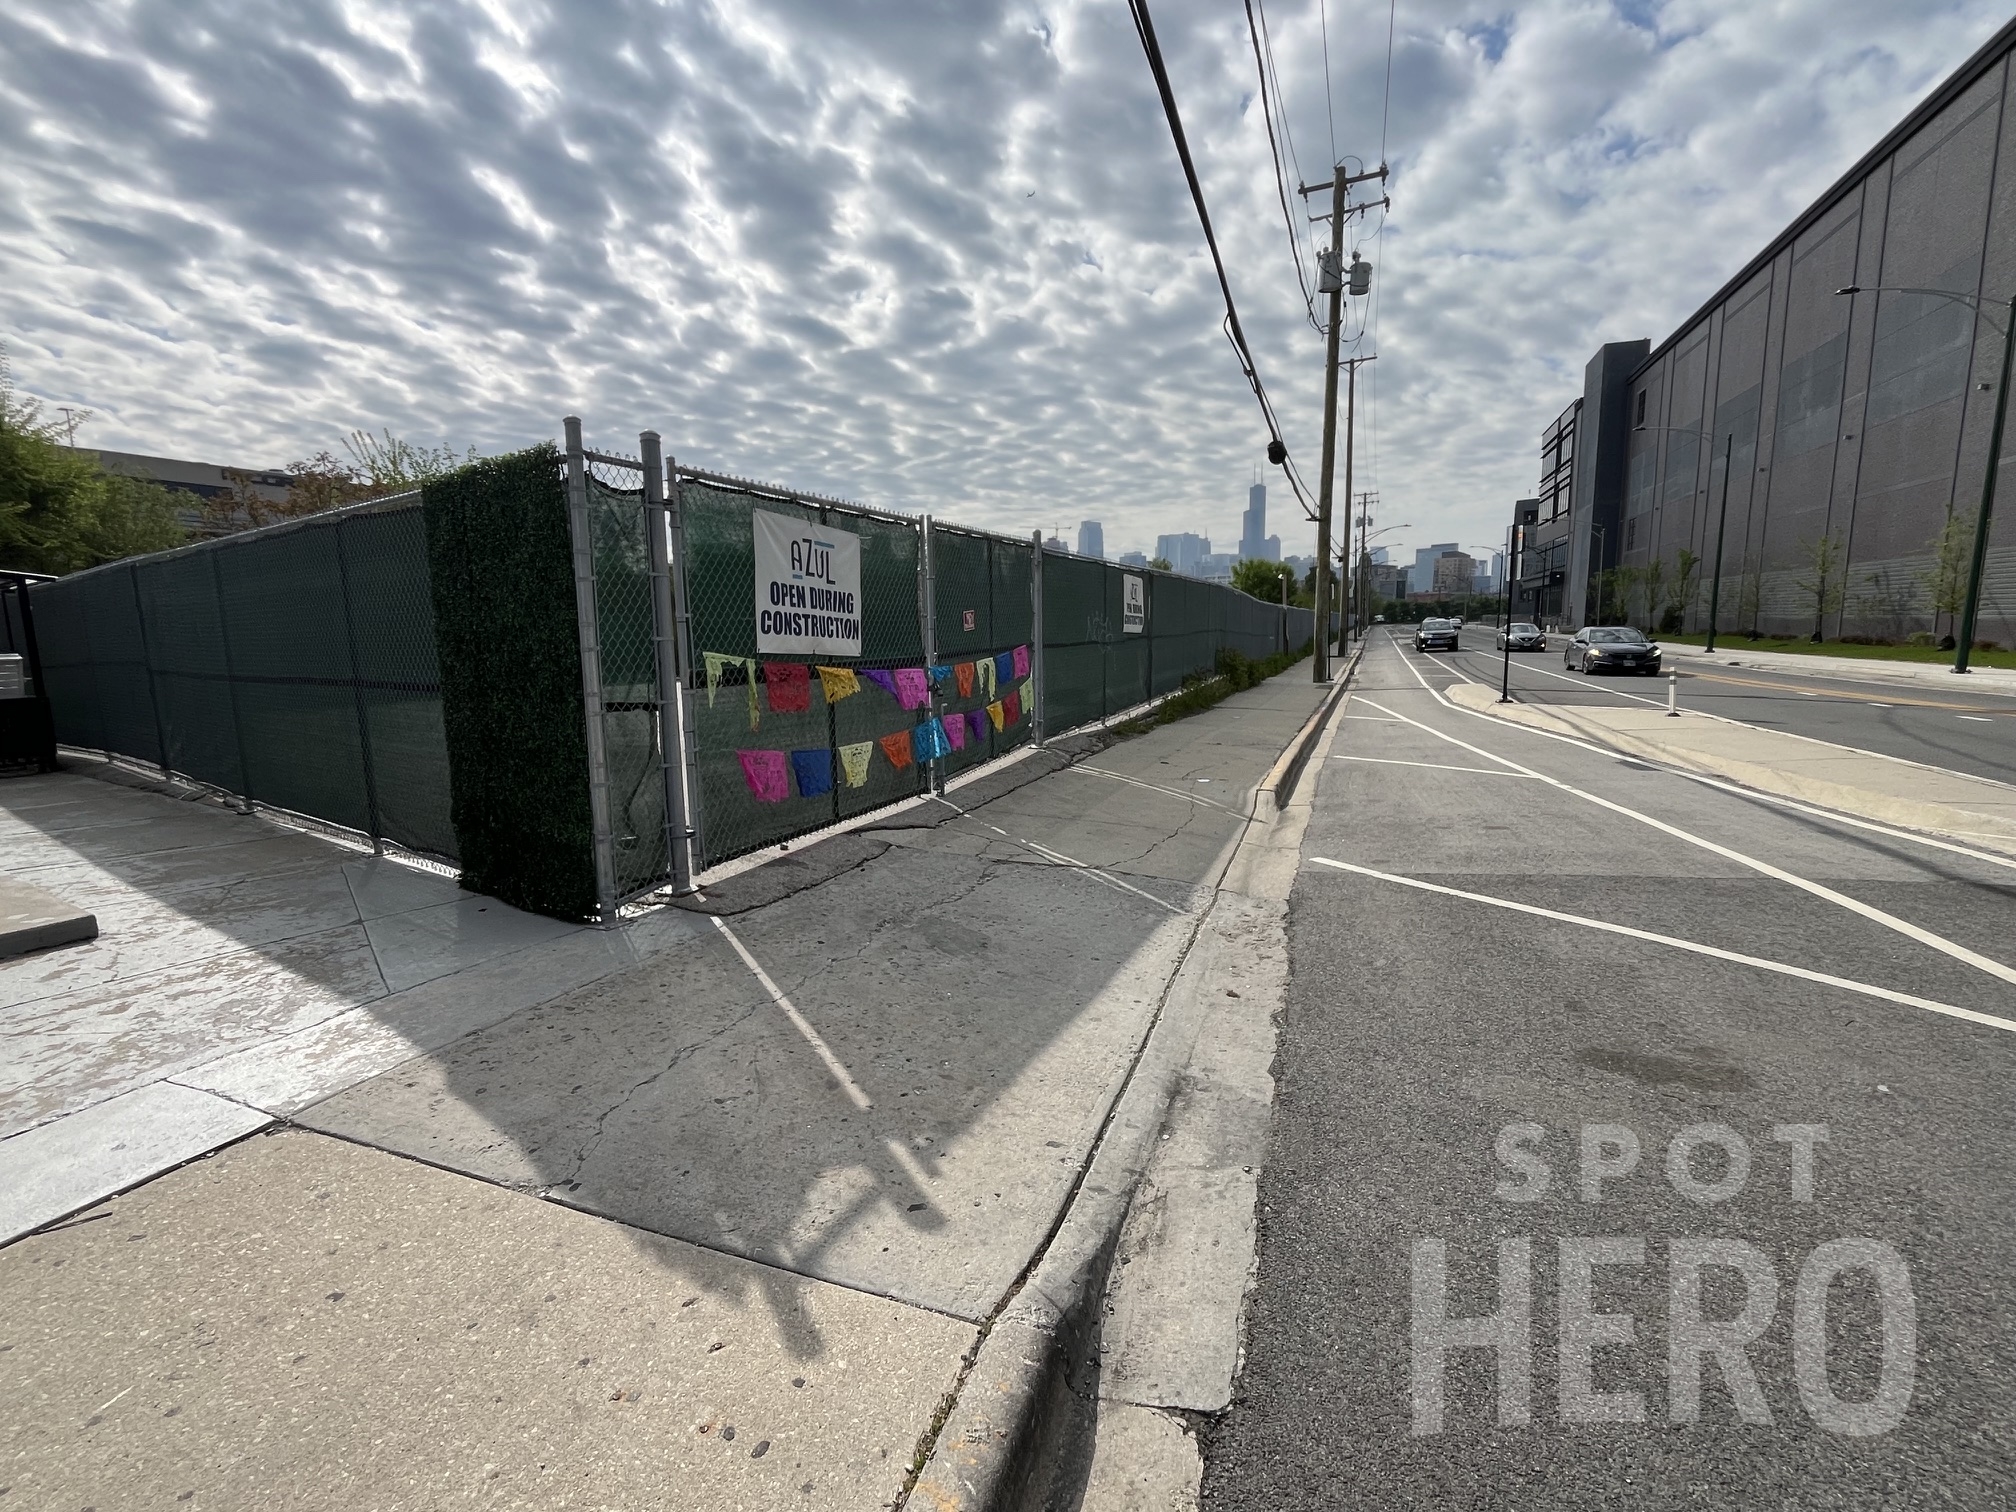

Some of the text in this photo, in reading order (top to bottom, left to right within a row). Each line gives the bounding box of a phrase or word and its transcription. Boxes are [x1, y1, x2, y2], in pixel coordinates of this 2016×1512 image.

[791, 539, 836, 584] AZUL
[770, 582, 854, 614] OPEN DURING
[761, 611, 859, 640] CONSTRUCTION
